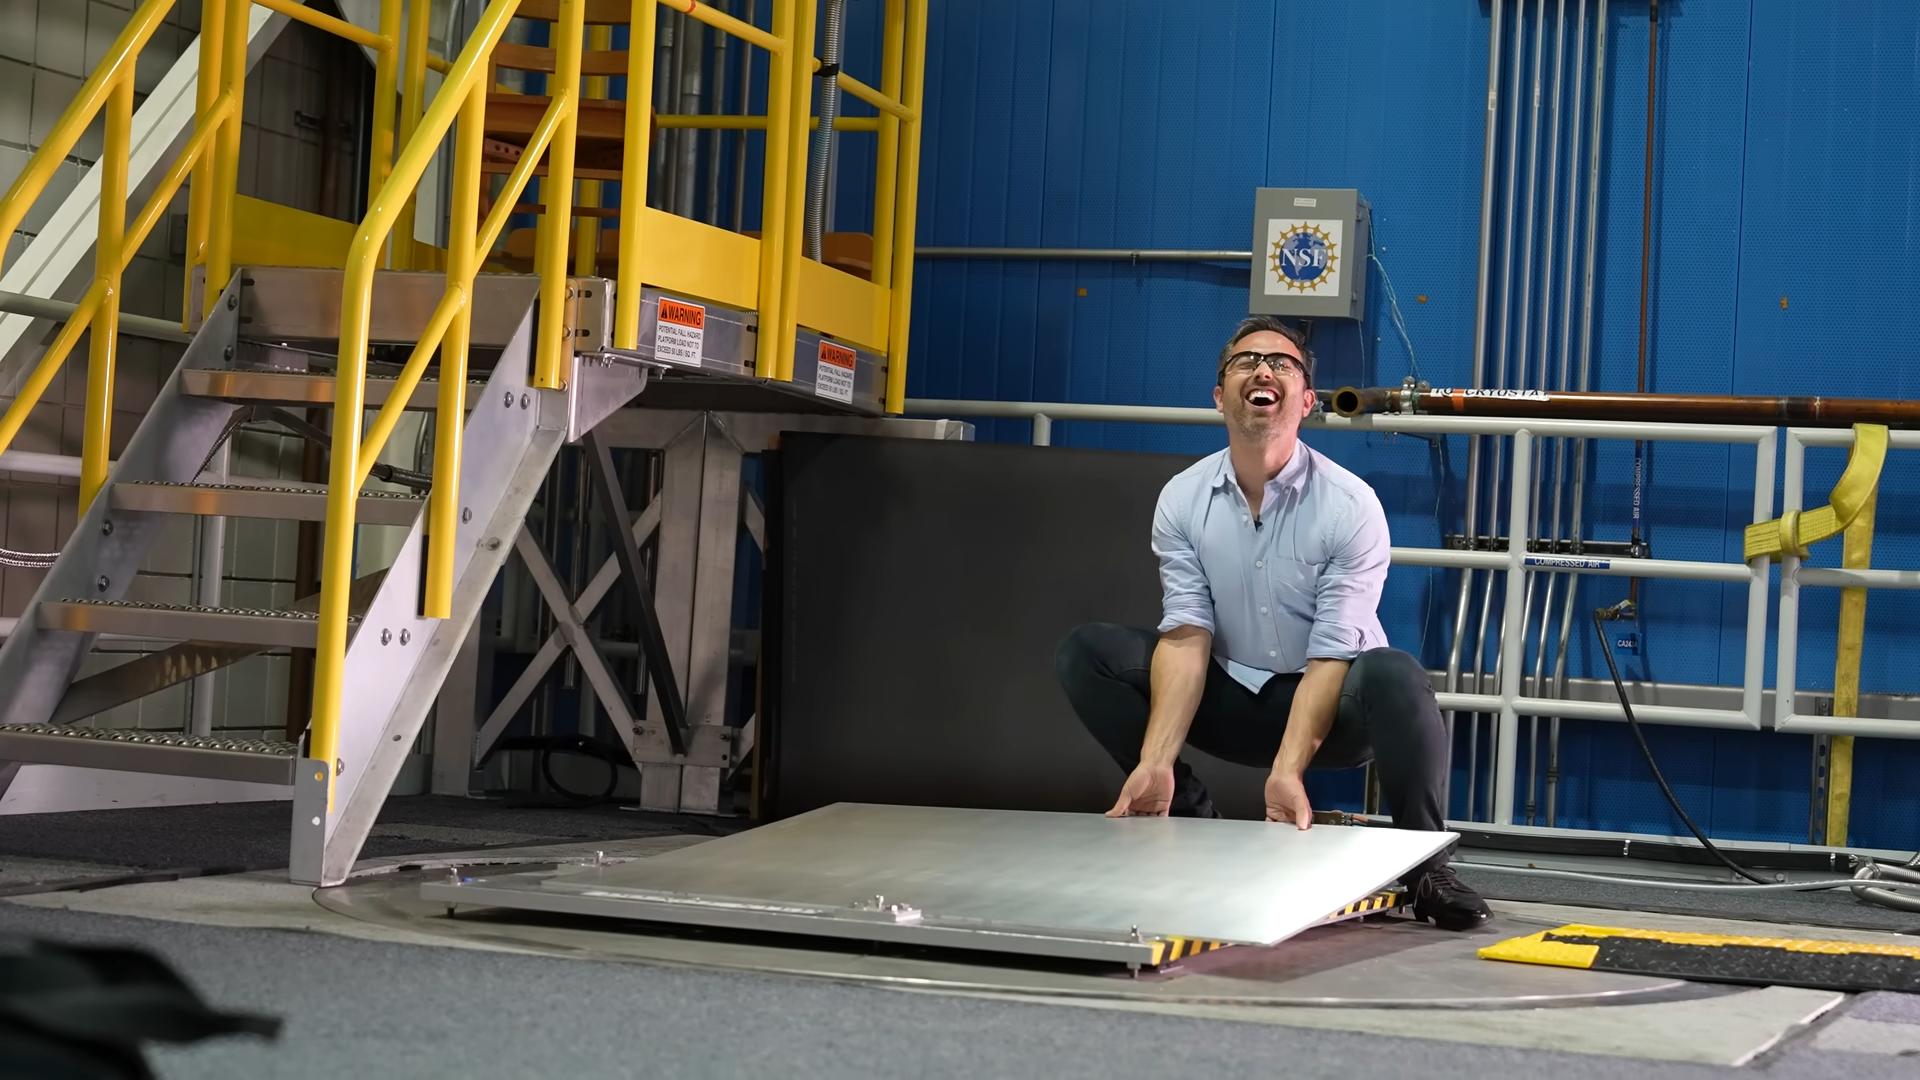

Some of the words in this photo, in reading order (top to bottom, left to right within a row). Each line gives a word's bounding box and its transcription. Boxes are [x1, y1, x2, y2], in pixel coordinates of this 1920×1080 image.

[1281, 248, 1326, 267] NSF
[668, 305, 702, 326] WARNING
[659, 325, 677, 335] POTENTIAL
[827, 348, 852, 367] WARNING
[1465, 387, 1548, 398] CRYOSTA
[1632, 506, 1640, 519] AIR
[1534, 558, 1585, 568] COMPRESSED
[1587, 560, 1600, 568] AIR
